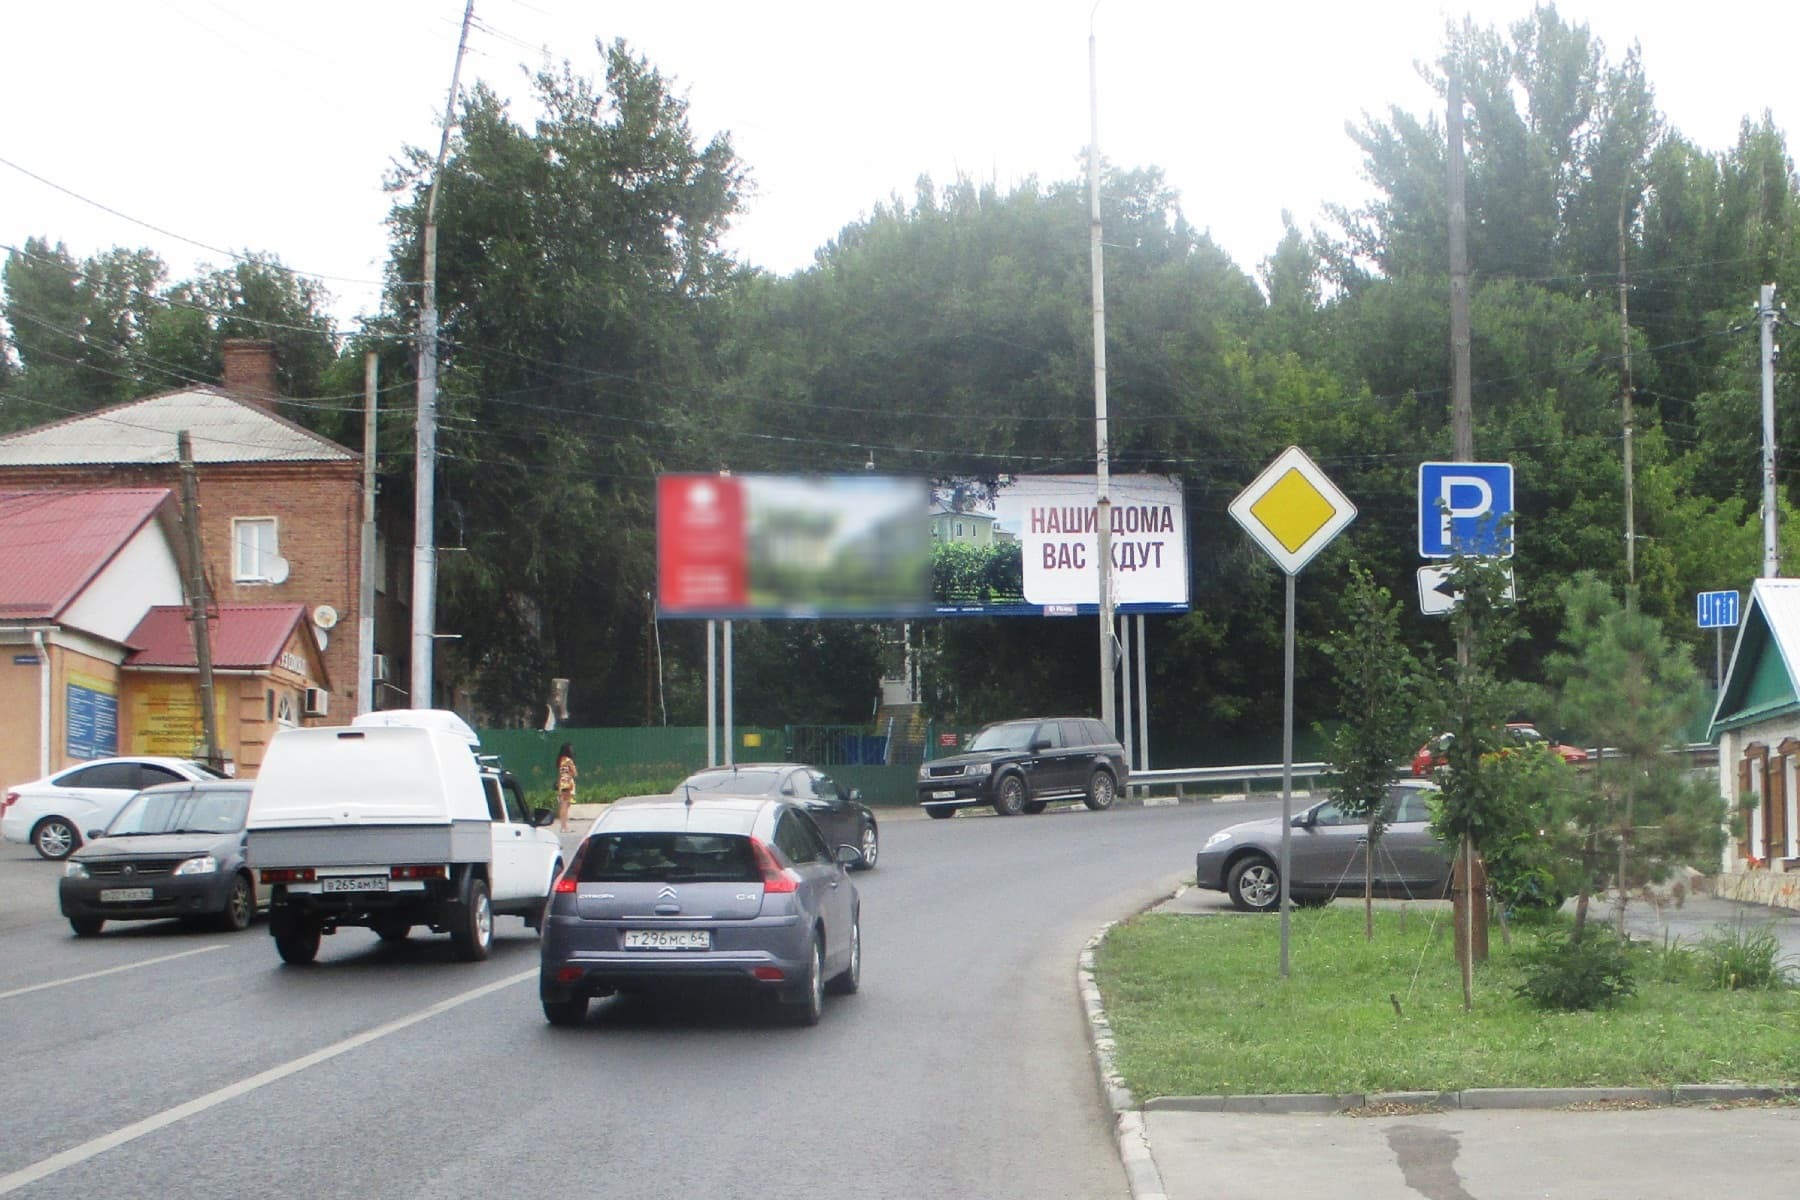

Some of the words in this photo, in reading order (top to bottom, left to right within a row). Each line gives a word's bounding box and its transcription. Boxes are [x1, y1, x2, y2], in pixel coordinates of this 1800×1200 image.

[1031, 506, 1098, 534] НАШИ
[1110, 506, 1174, 536] ДОМА
[1441, 476, 1492, 545] P
[1042, 542, 1086, 570] ВАС
